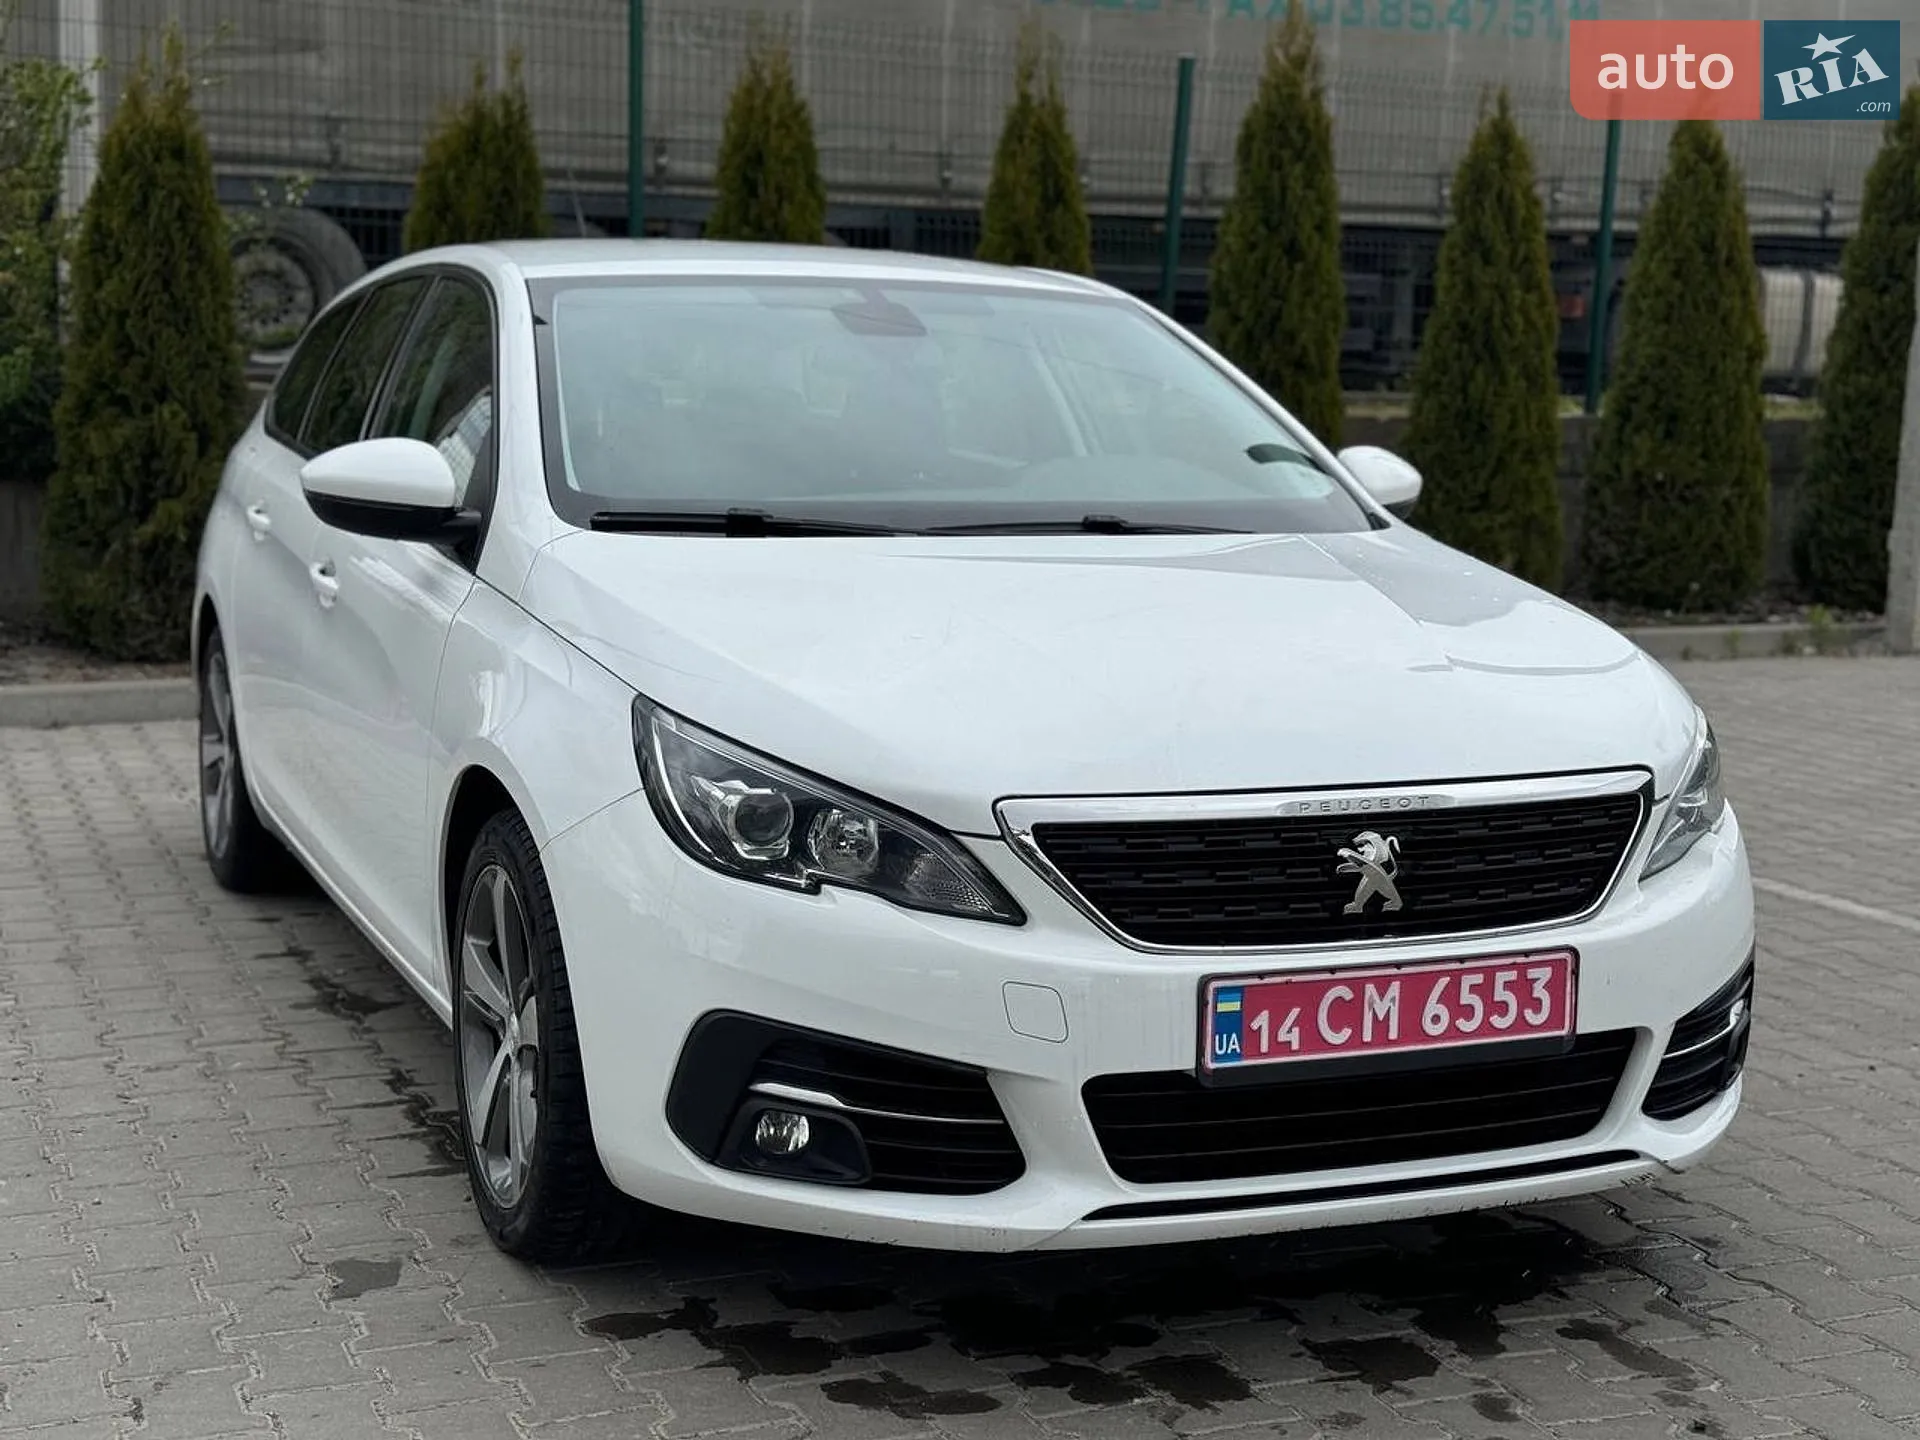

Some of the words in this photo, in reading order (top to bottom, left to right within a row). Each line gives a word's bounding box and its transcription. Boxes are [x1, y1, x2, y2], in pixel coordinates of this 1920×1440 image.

[1300, 796, 1429, 814] PEUGEOT
[1249, 1007, 1301, 1053] 14
[1316, 980, 1401, 1046] CM
[1421, 966, 1553, 1037] 6553
[1214, 1031, 1241, 1055] UA
